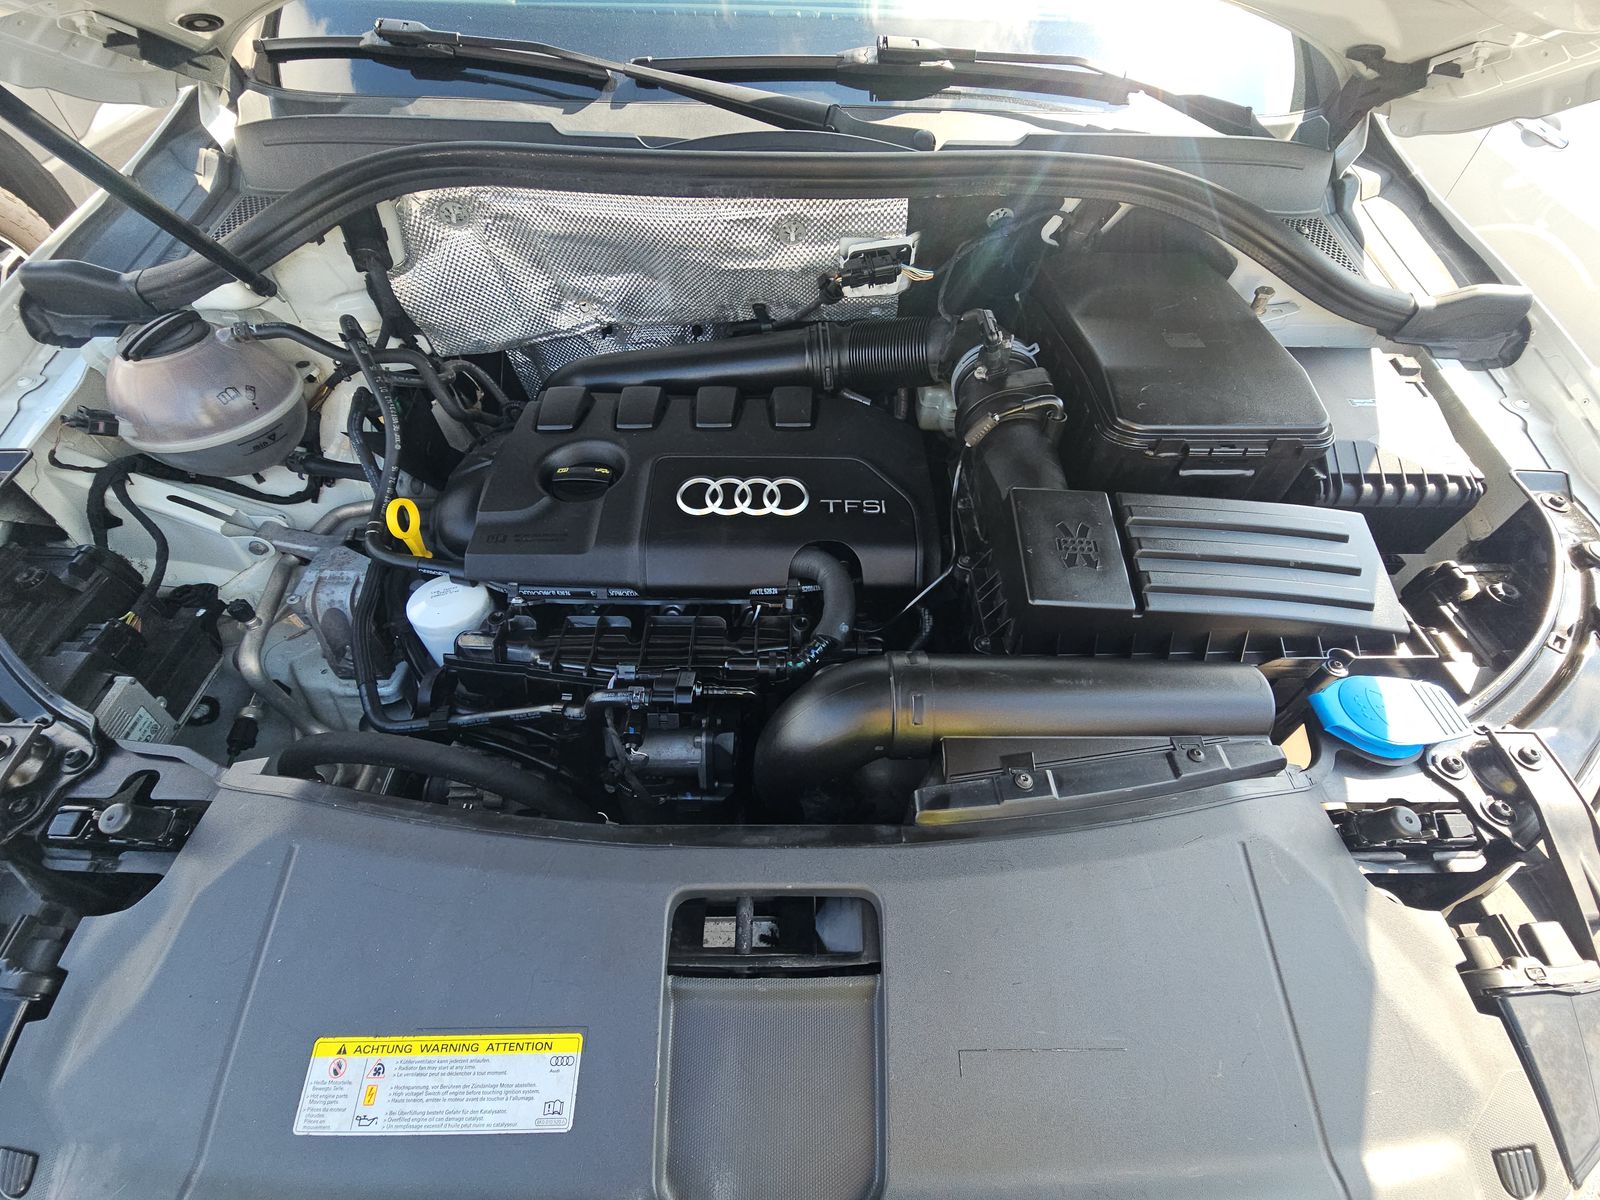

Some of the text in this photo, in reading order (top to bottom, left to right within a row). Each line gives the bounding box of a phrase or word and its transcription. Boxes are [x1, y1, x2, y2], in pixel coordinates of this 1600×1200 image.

[252, 440, 268, 450] min
[820, 500, 886, 513] TFSI
[353, 1042, 553, 1054] ACHTUNG WARNING ATTENTION
